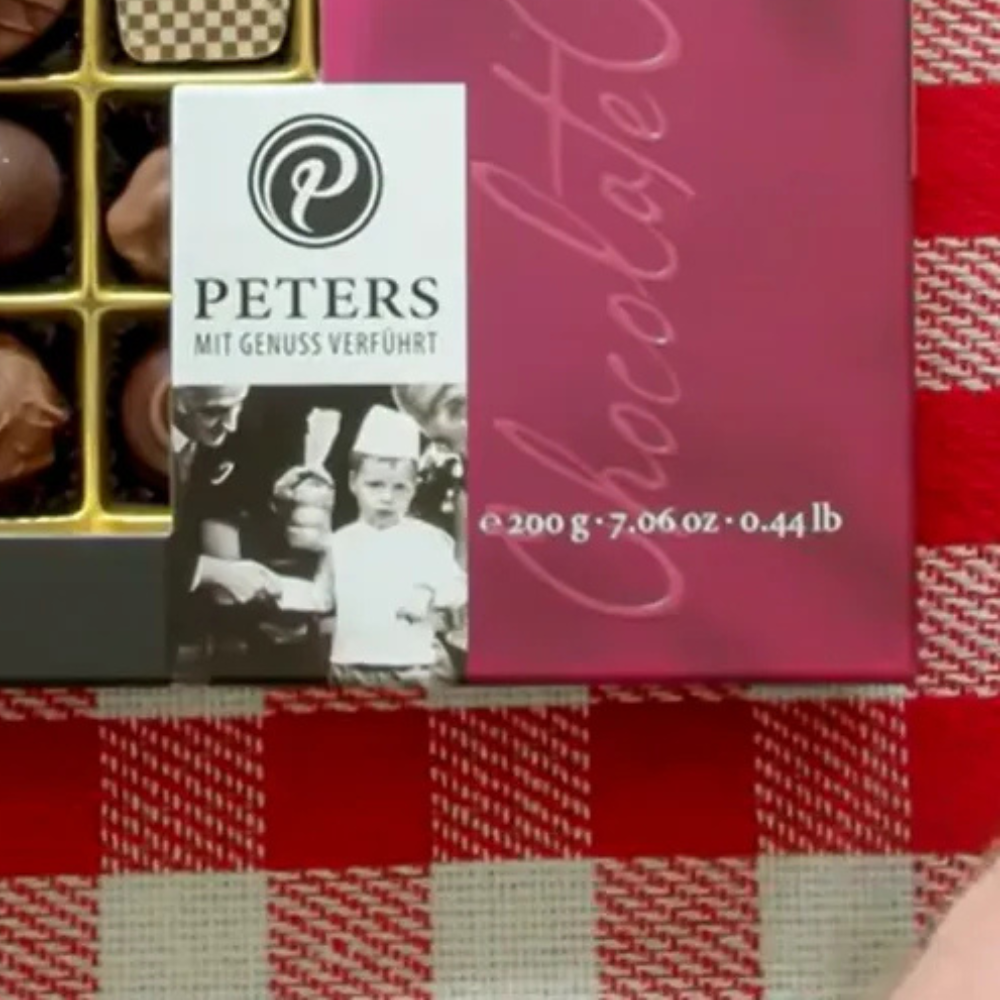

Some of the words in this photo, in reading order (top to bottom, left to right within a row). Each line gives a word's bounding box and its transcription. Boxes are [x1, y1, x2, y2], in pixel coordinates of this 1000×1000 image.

[193, 276, 440, 321] PETERS
[194, 331, 232, 355] MIT
[239, 331, 322, 355] GENUSS
[328, 327, 438, 355] VERFÜHRT
[508, 512, 565, 534] 200
[570, 512, 590, 543] g
[608, 506, 677, 539] 7.06
[682, 511, 719, 533] oz
[740, 511, 804, 538] 0.44
[811, 501, 842, 533] lb
